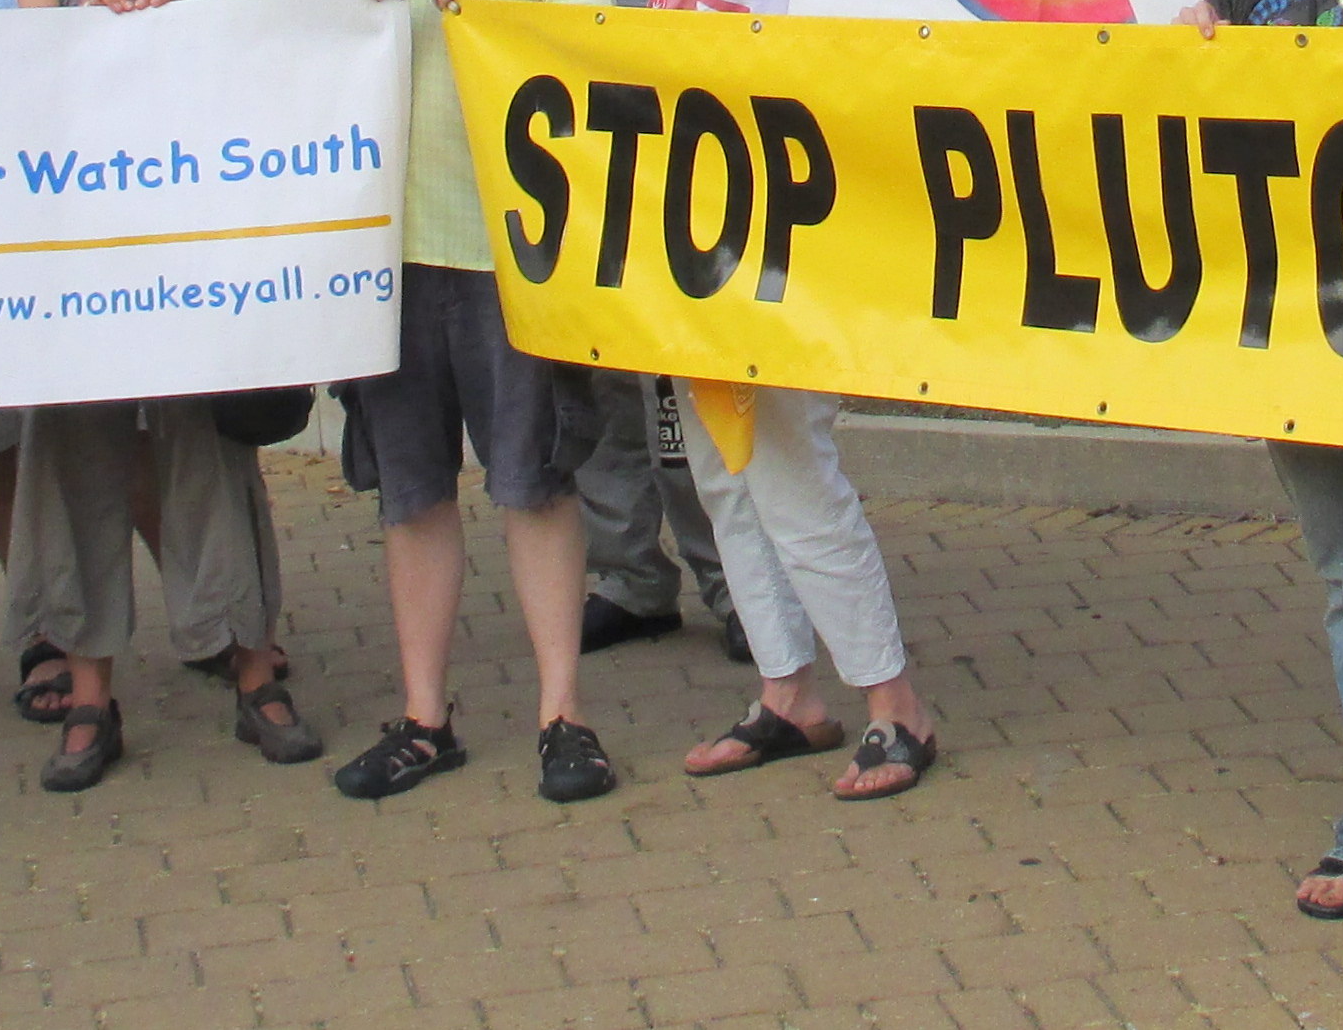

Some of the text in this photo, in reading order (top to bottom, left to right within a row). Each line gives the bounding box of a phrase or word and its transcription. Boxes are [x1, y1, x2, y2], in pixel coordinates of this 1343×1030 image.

[18, 141, 200, 195] Watch
[219, 124, 382, 182] South
[504, 74, 838, 303] STOP
